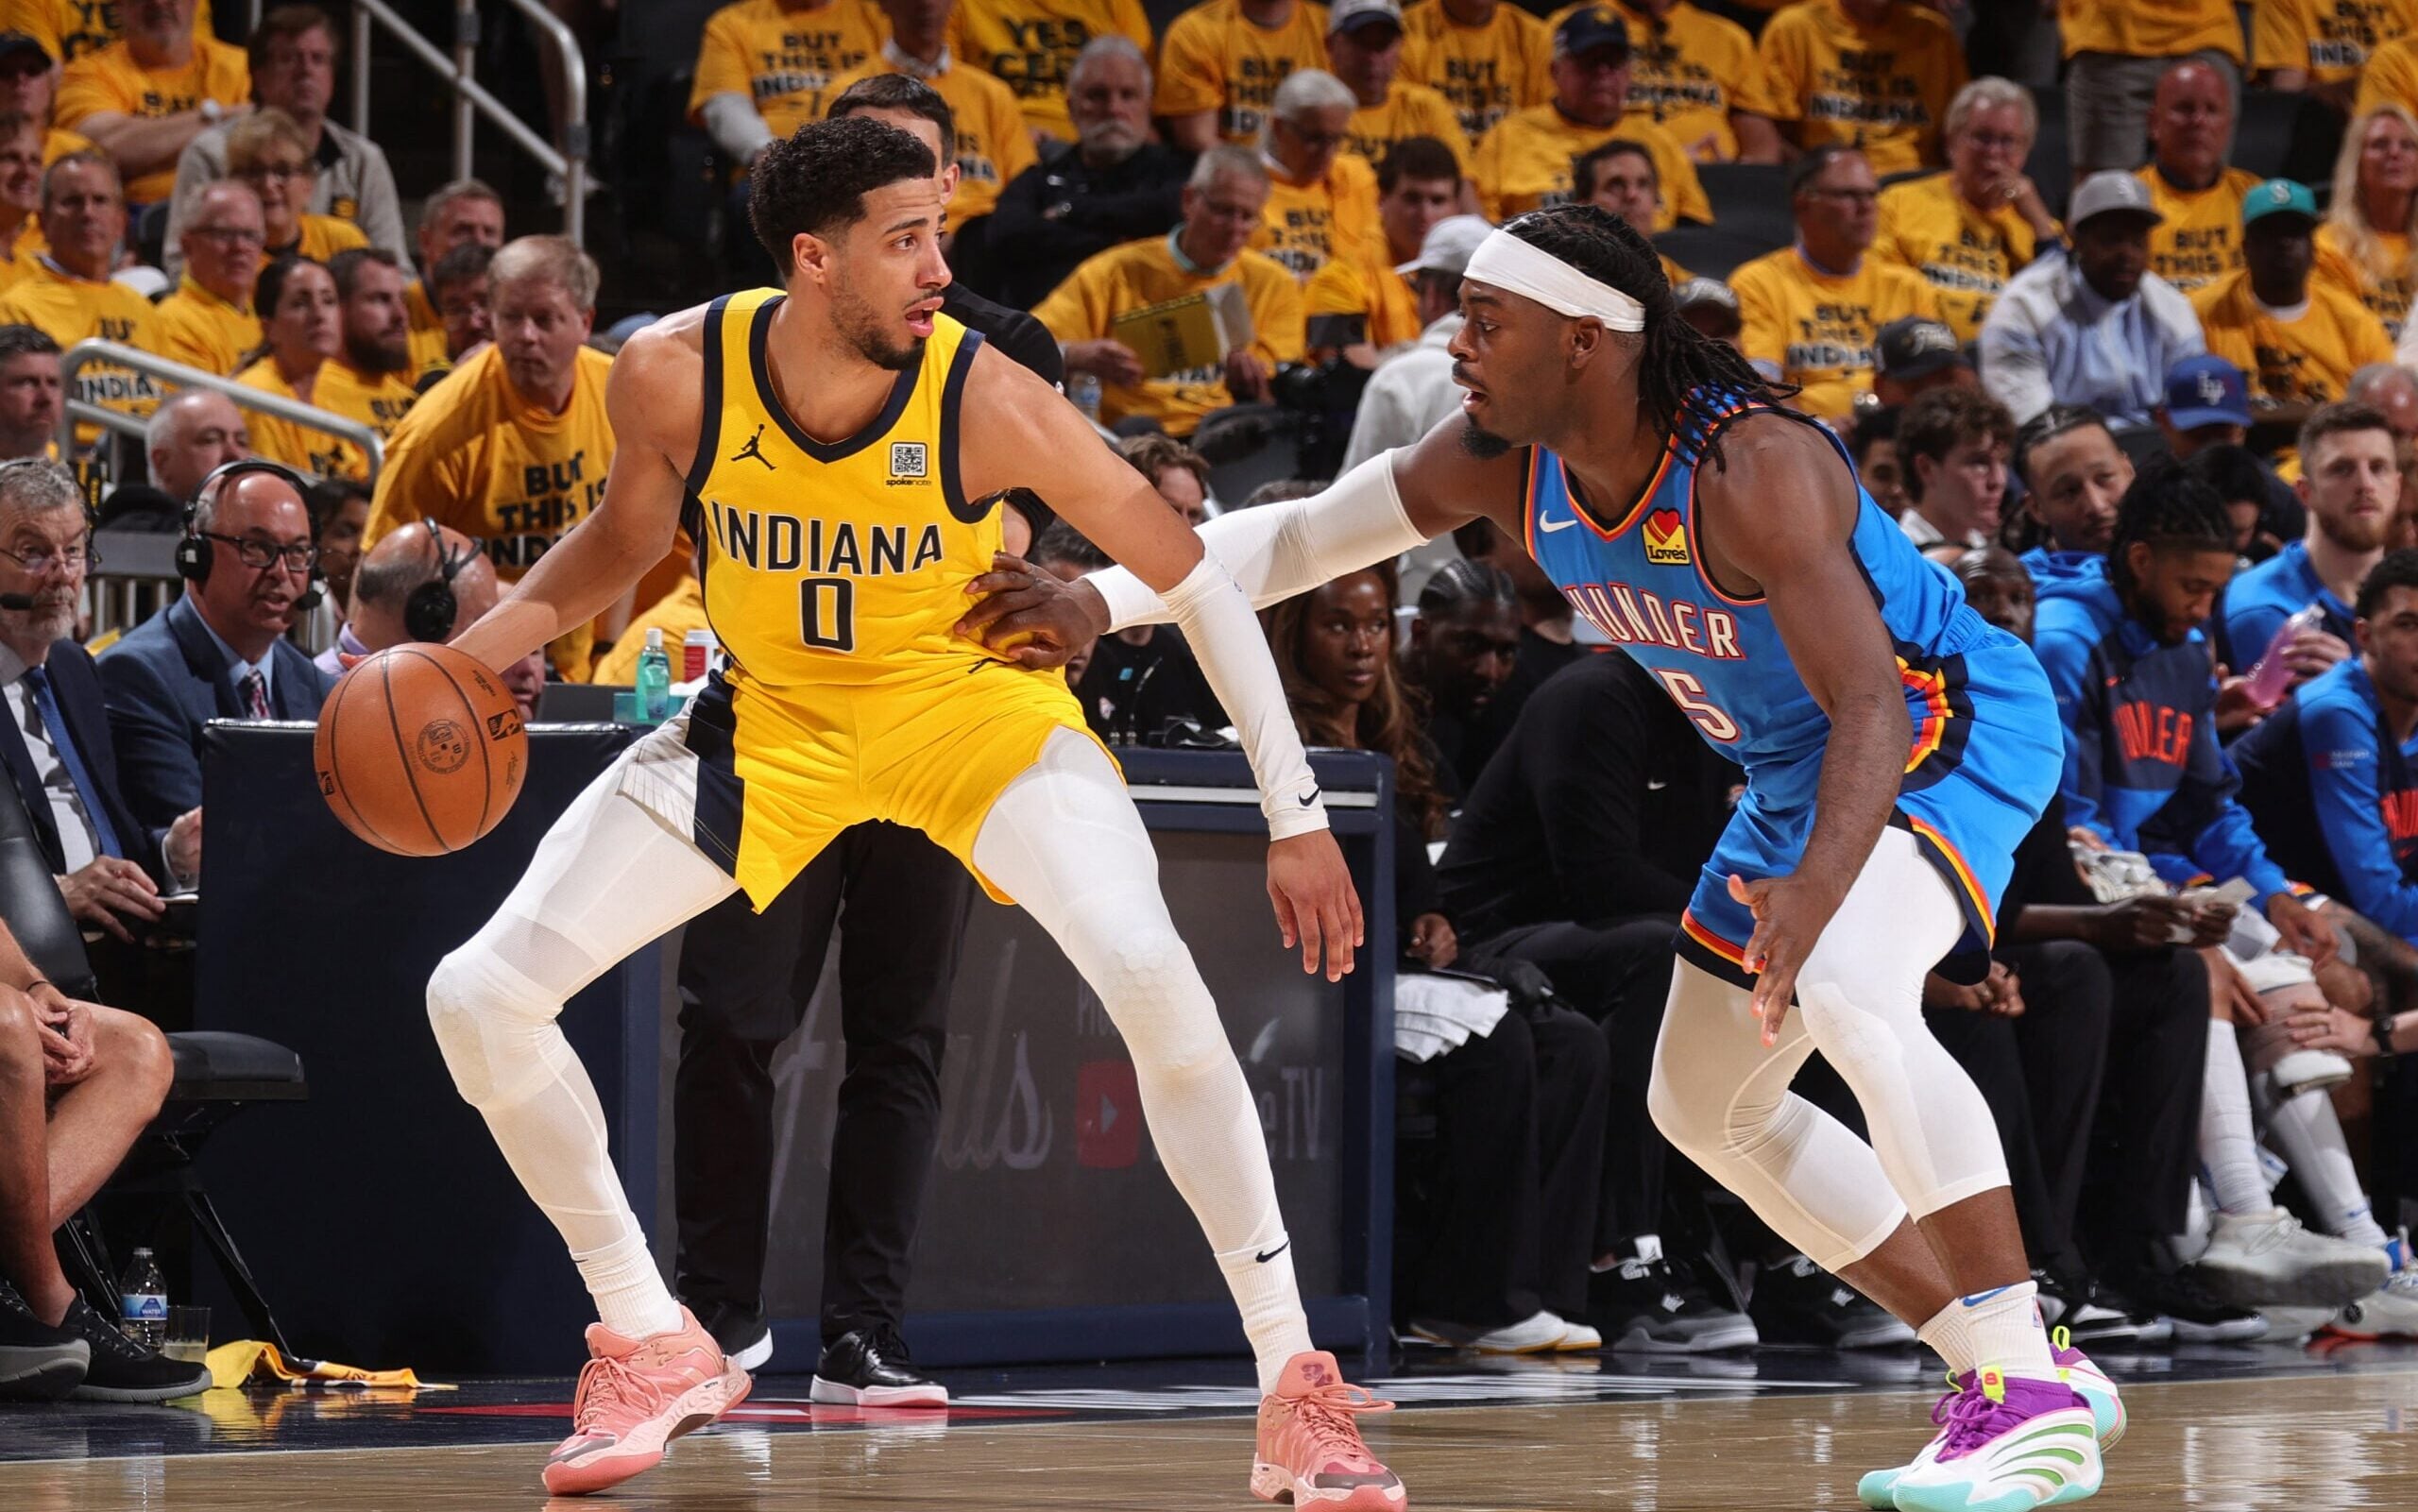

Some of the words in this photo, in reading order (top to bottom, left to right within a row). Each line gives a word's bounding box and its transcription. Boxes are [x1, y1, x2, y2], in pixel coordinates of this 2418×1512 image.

[762, 52, 832, 70] THIS
[783, 31, 842, 49] BUT
[525, 450, 584, 497] BUT
[885, 477, 931, 487] spokenote
[710, 500, 945, 577] INDIANA
[799, 577, 856, 654] 0
[1649, 667, 1741, 743] 5
